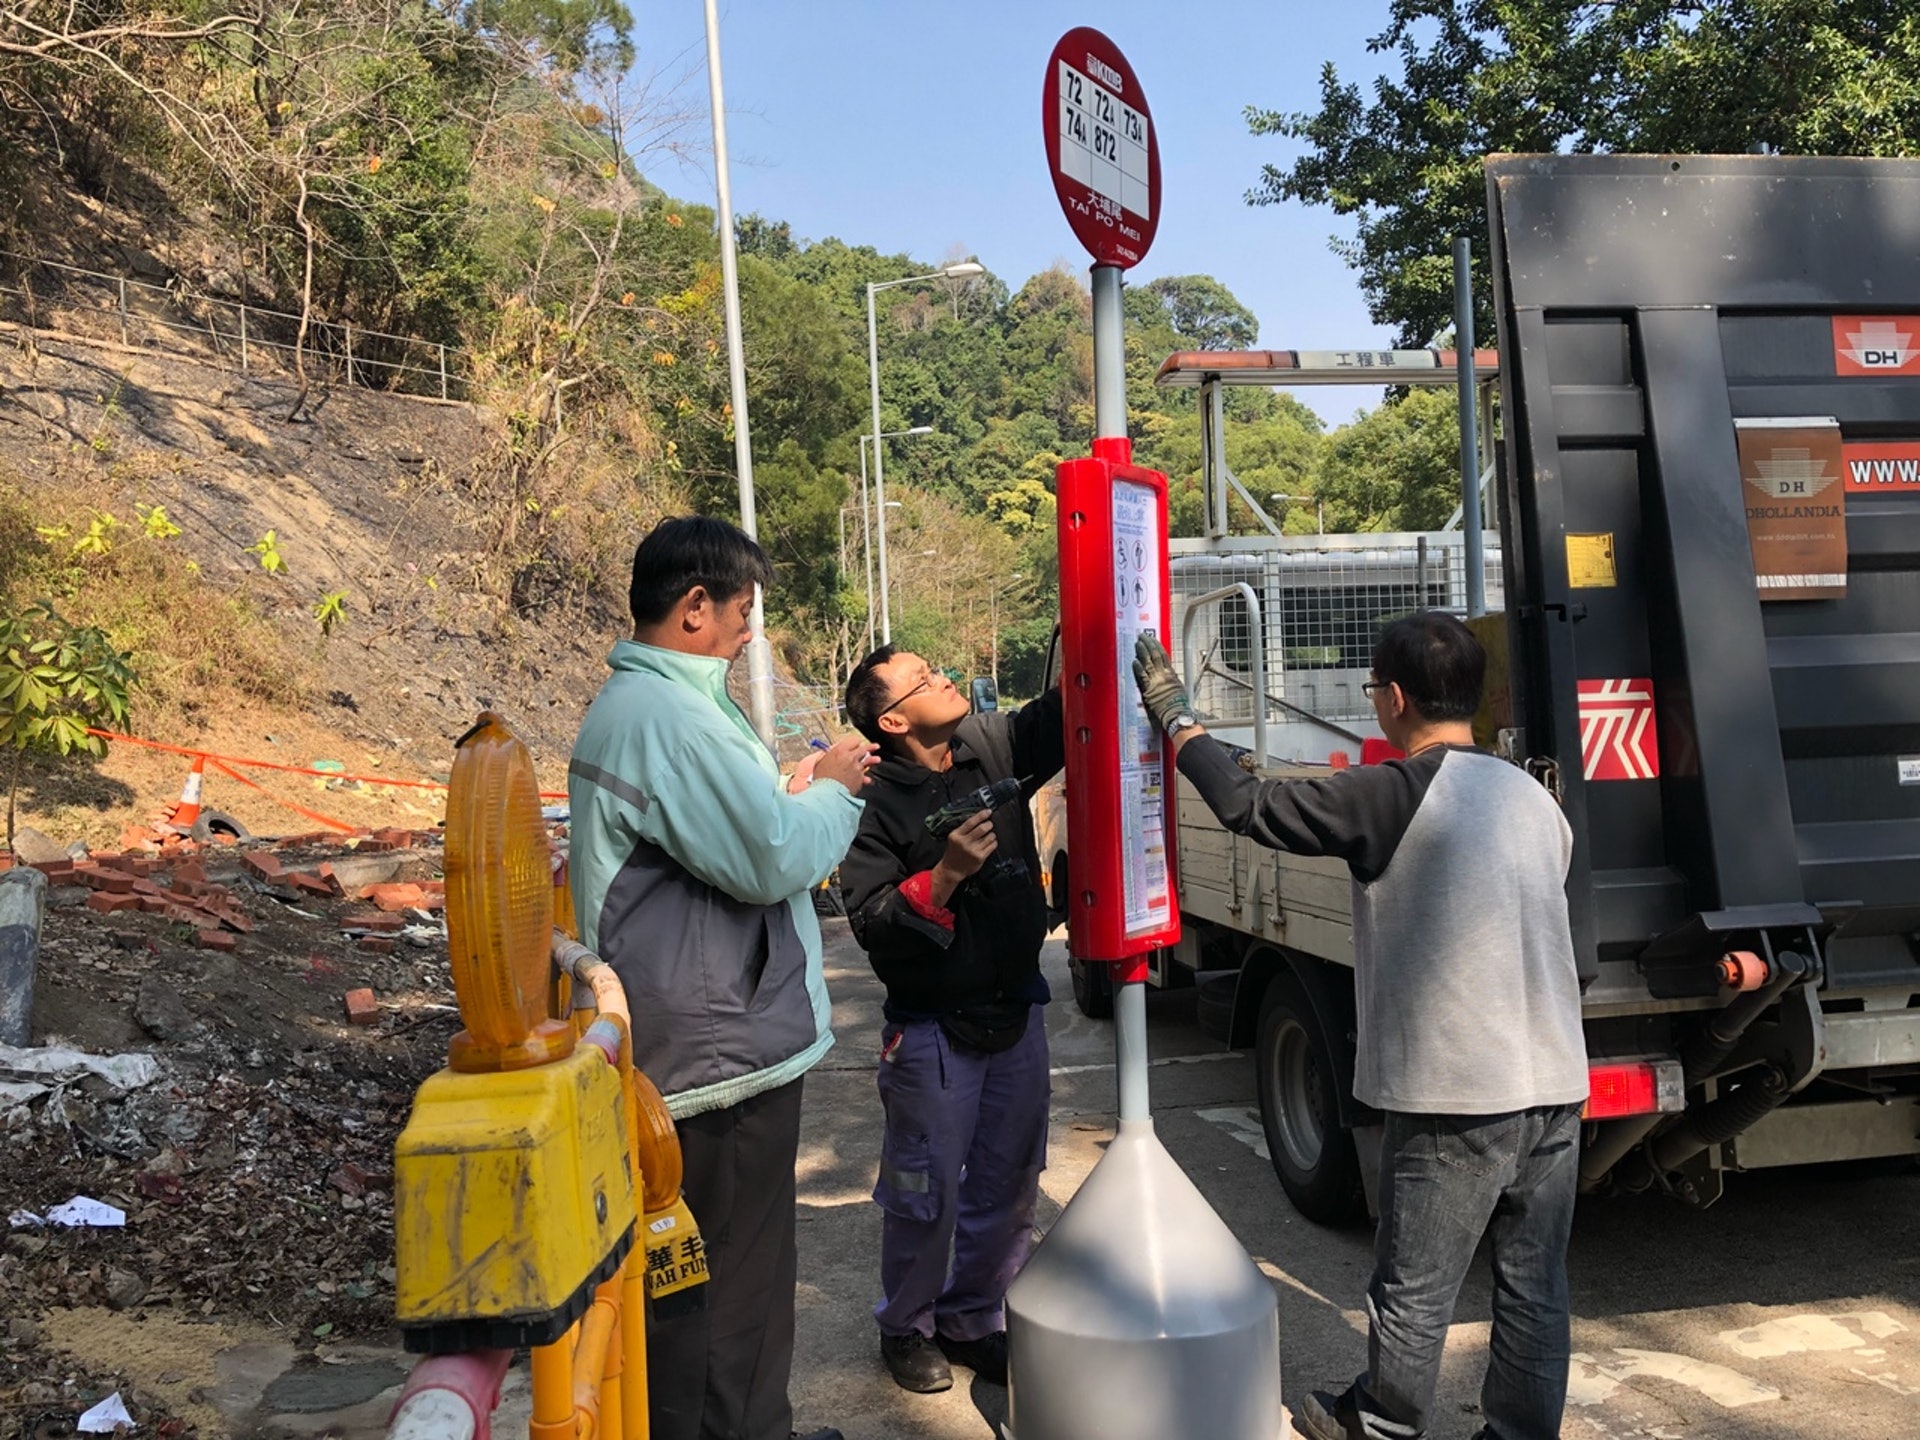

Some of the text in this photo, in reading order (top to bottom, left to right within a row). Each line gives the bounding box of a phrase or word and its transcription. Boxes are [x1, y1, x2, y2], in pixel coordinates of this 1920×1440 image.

[1066, 69, 1143, 145] 72 72A 73A
[1066, 106, 1116, 162] 74A 872
[1068, 196, 1140, 242] TAI PO MEI
[1336, 352, 1396, 368] 工程車
[1864, 350, 1898, 364] DH
[1747, 505, 1842, 519] DHOLLANDIA
